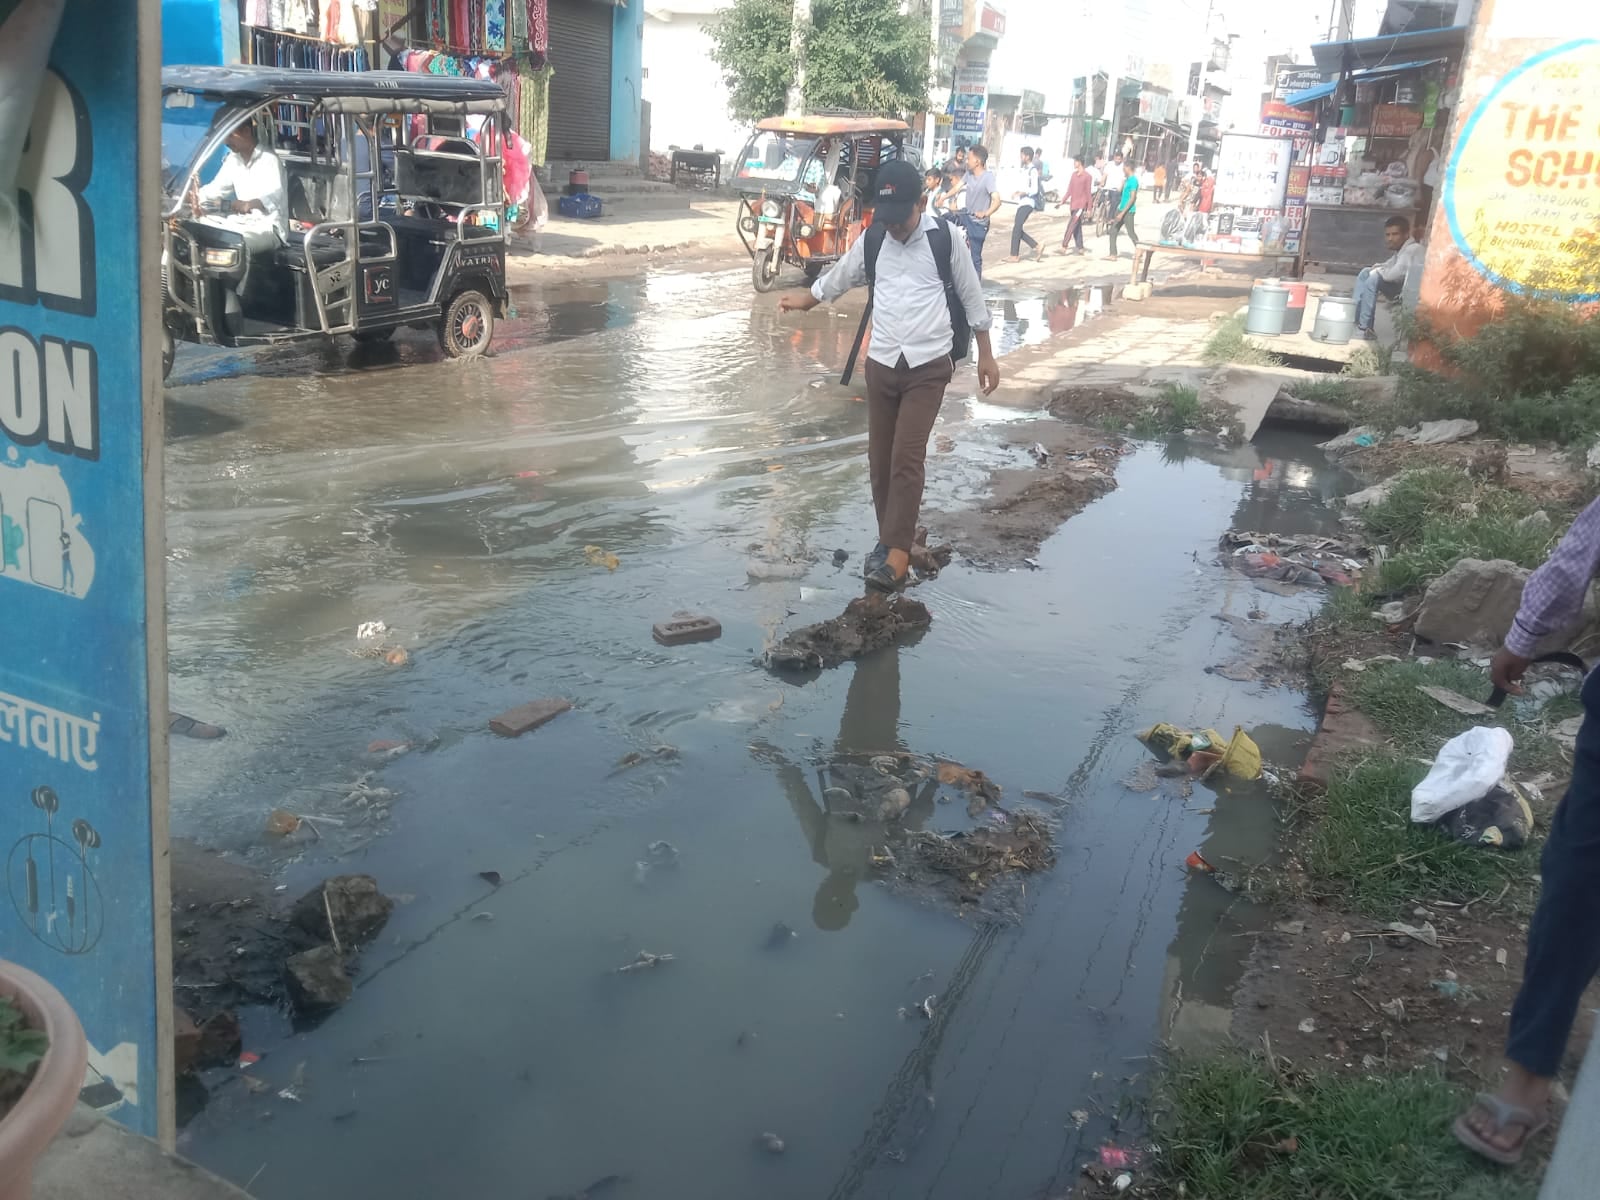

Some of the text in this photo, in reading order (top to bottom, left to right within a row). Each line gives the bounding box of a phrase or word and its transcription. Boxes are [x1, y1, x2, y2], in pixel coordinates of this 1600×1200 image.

[1500, 101, 1584, 142] THE
[1494, 221, 1561, 237] HOSTEL
[461, 256, 491, 267] YATRI
